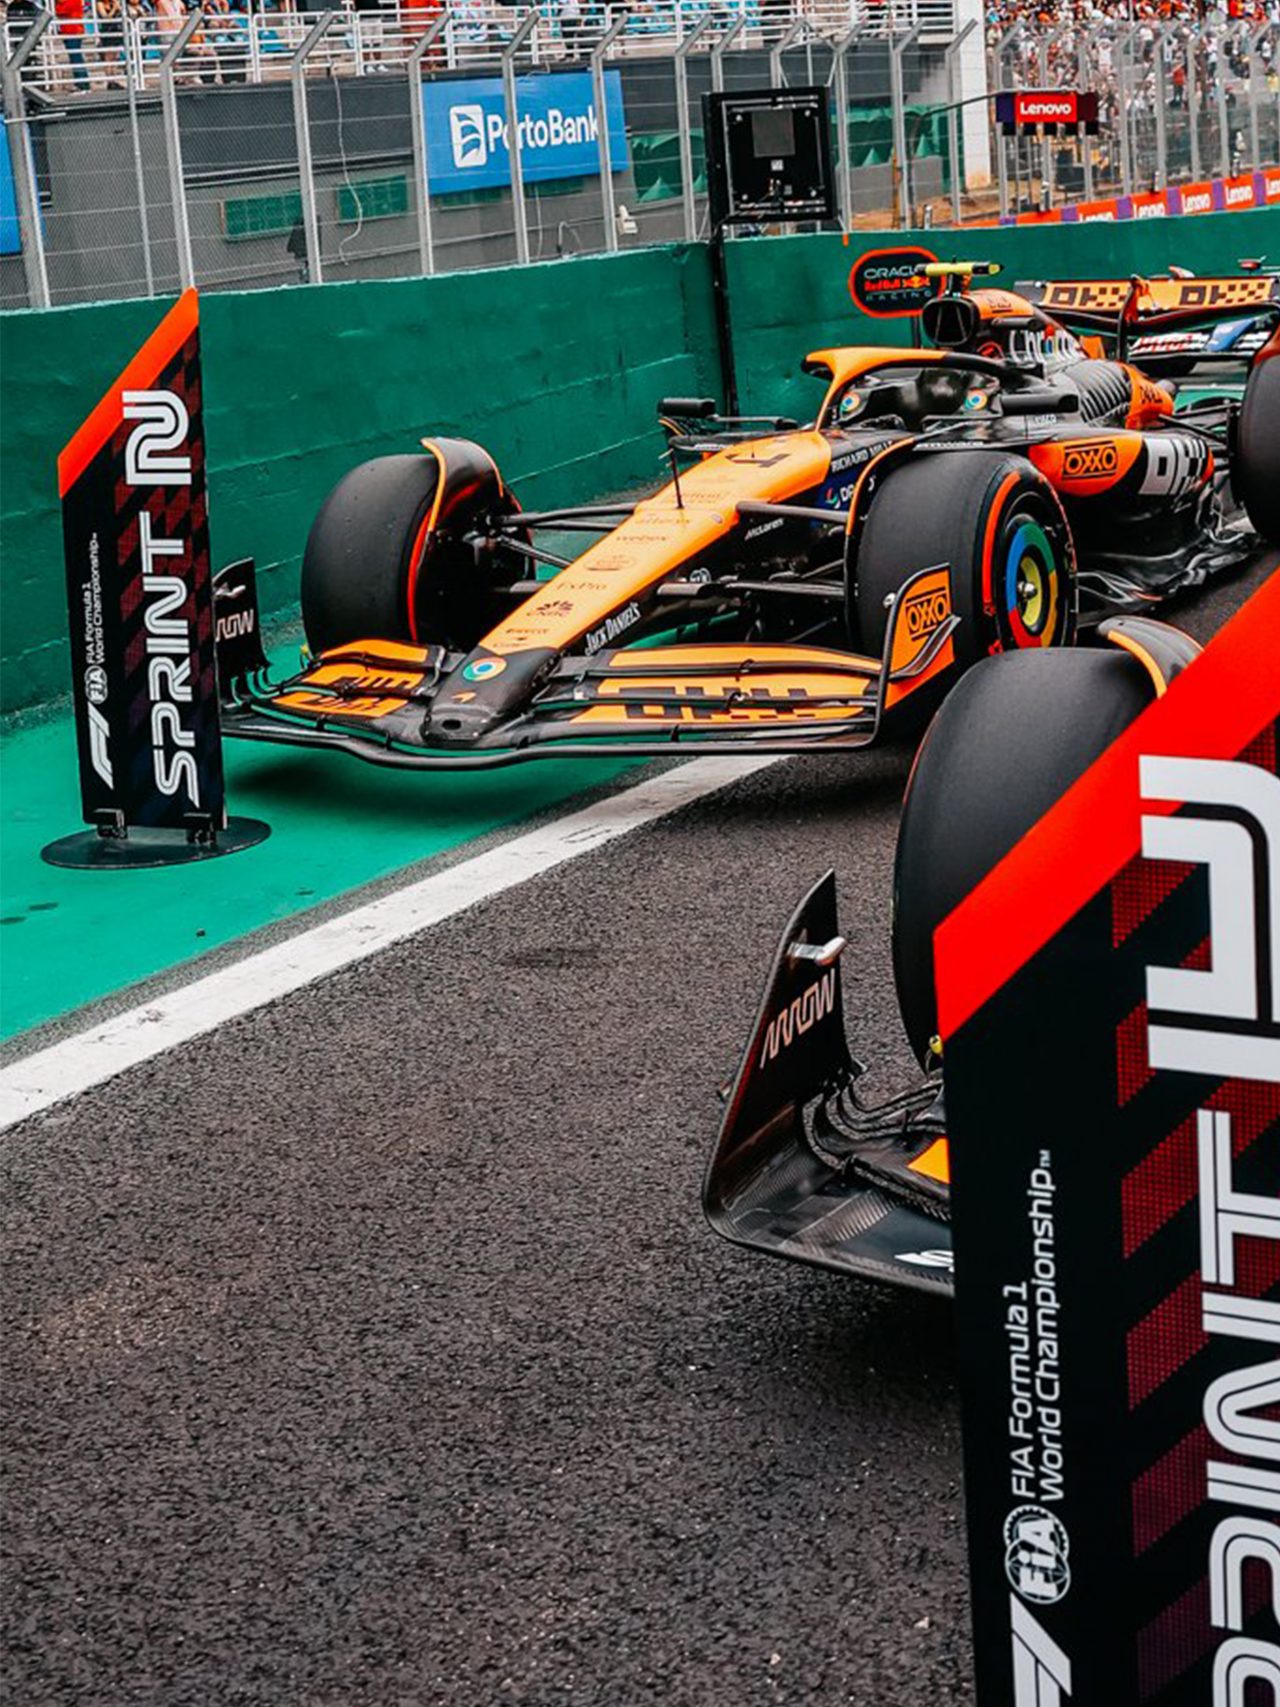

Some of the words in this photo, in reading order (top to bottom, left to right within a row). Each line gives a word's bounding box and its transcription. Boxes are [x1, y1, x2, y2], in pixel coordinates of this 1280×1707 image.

[1020, 102, 1073, 115] Lenovo
[864, 265, 916, 279] ORACL
[122, 390, 191, 485] 2
[1066, 445, 1117, 474] OXXO
[744, 517, 785, 541] McLaren
[905, 593, 949, 634] OXXO
[139, 511, 200, 809] SPRINT
[585, 627, 609, 656] JACK
[760, 967, 835, 1070] ARROW
[1002, 1280, 1028, 1301] 1
[1004, 1304, 1034, 1440] Formula
[1009, 1444, 1037, 1498] FIA
[1036, 1405, 1065, 1501] World
